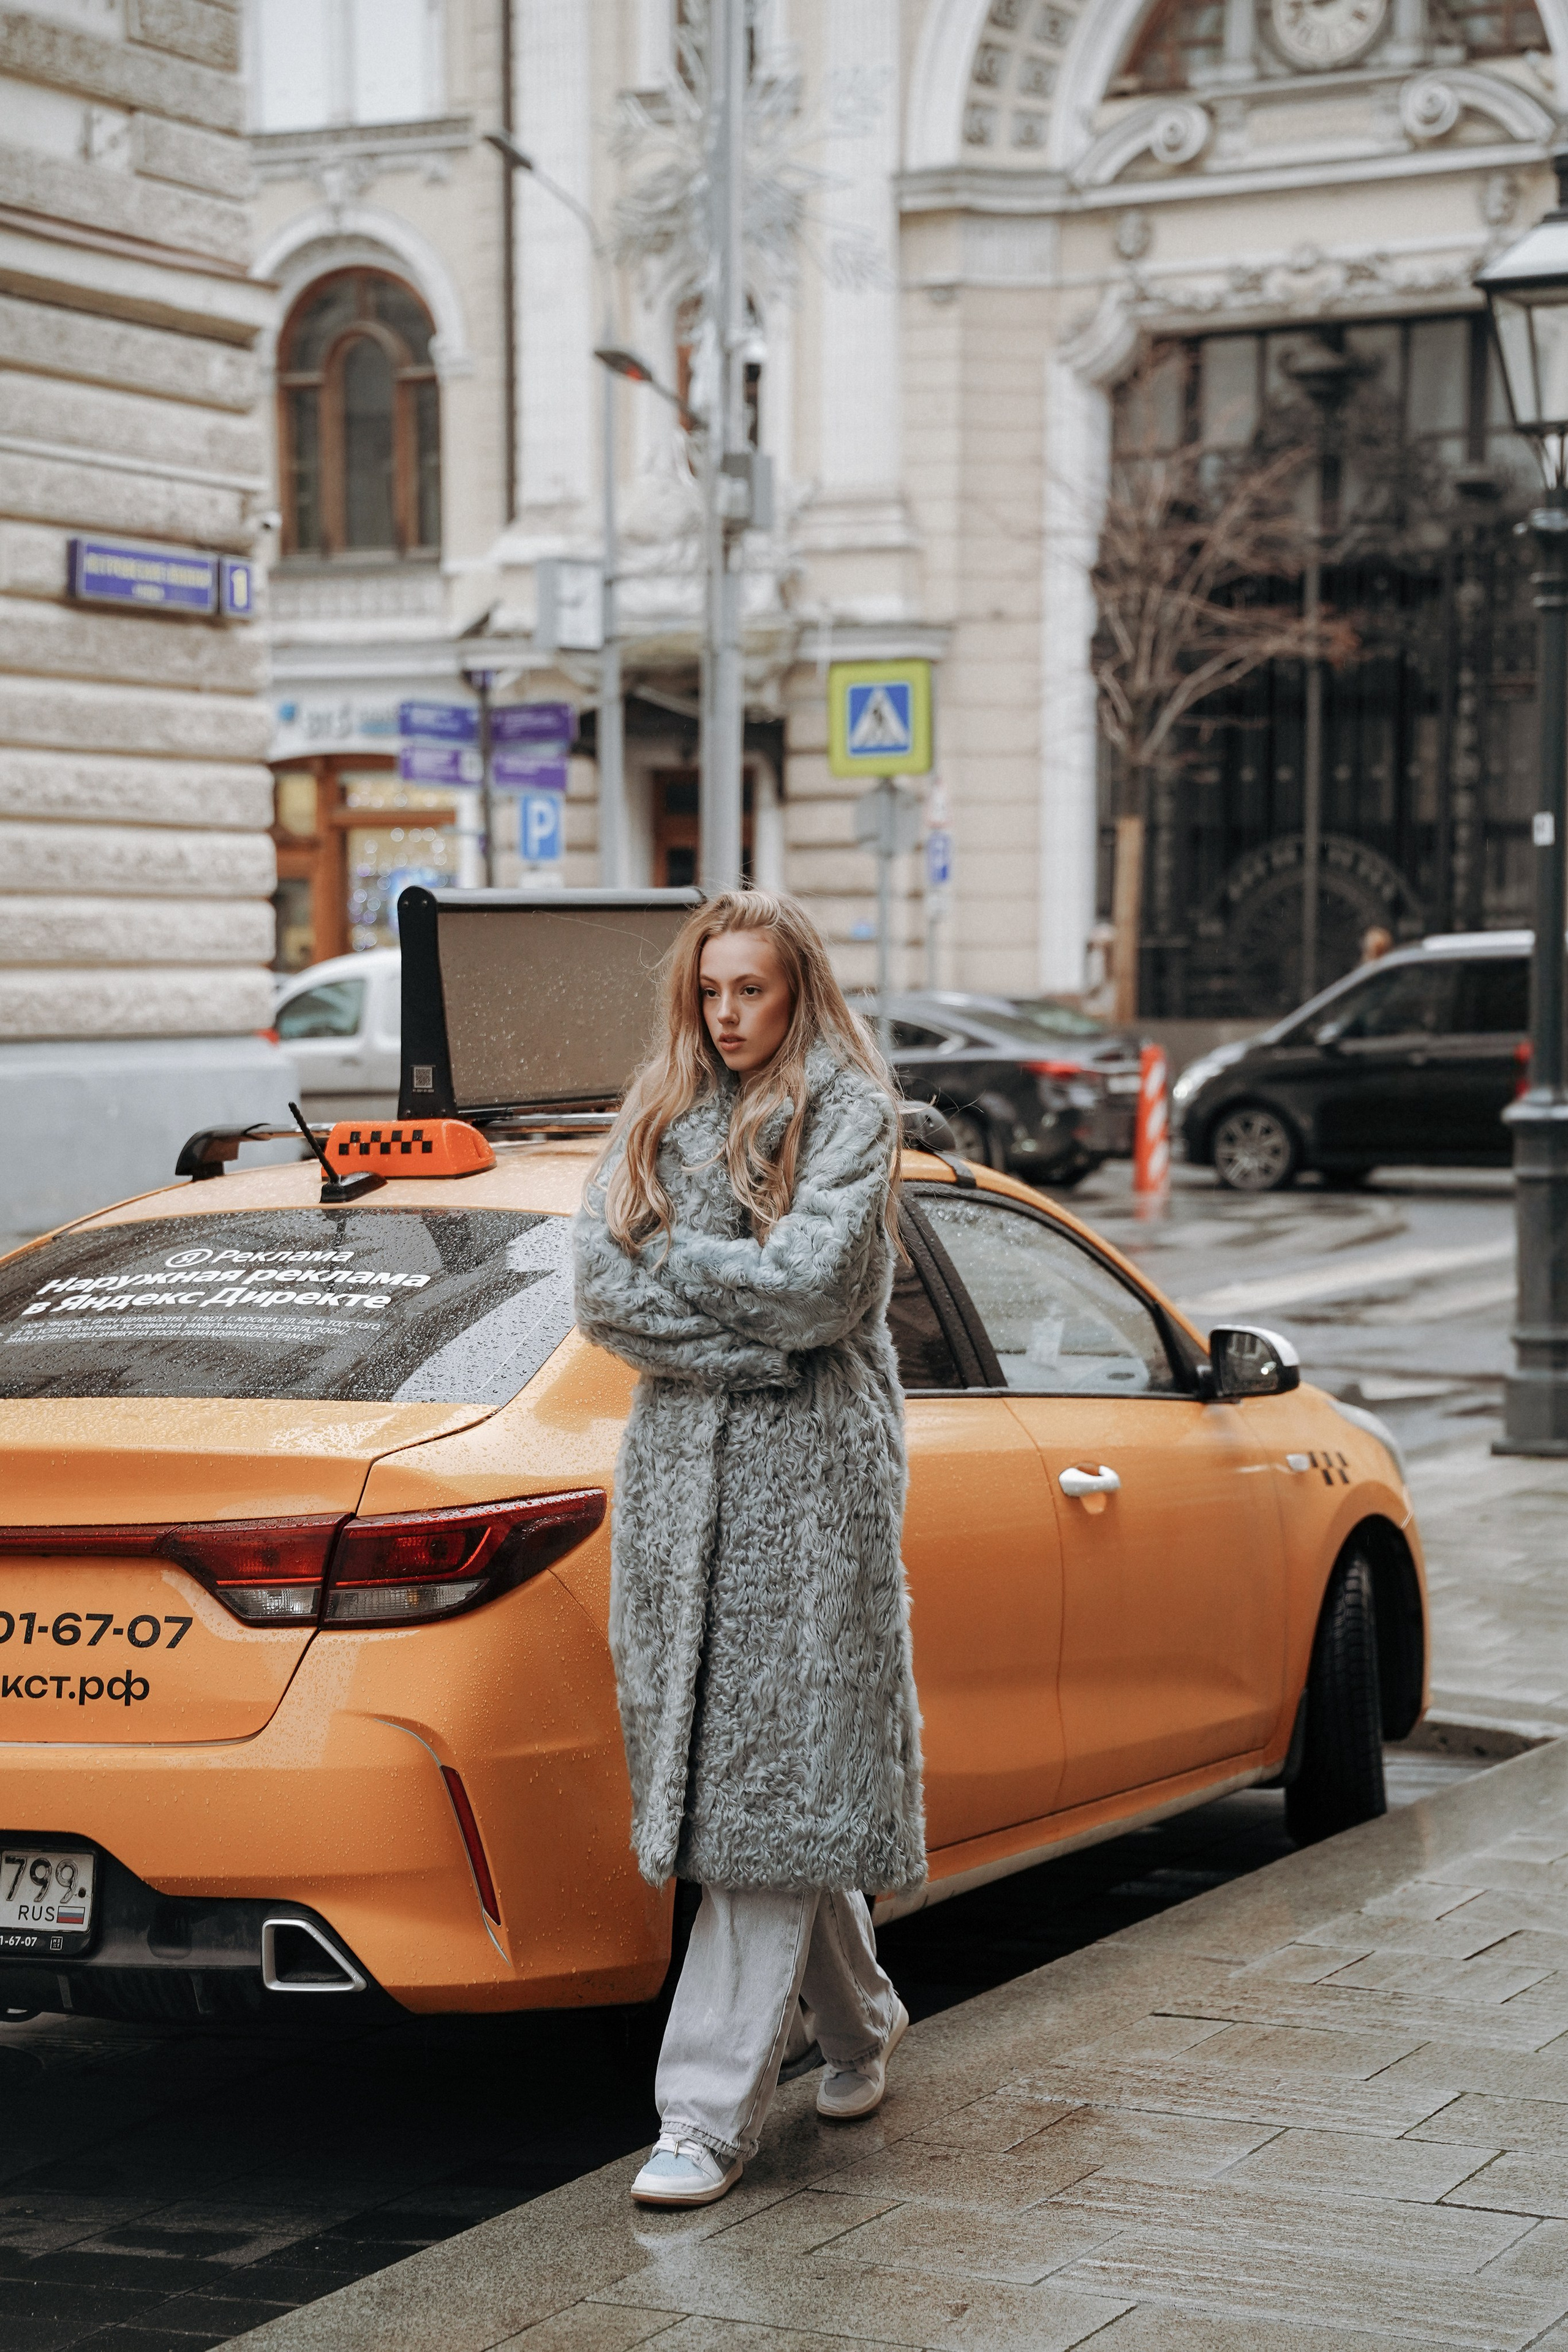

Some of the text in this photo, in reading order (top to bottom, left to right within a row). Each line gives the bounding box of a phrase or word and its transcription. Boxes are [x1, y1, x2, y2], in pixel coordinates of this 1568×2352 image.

[211, 1250, 355, 1263] Реклама
[36, 1269, 431, 1295] Наружная реклама
[21, 1287, 392, 1316] в Яндекс Директе
[327, 1320, 381, 1331] ТОЛСТОГО,
[2, 1670, 149, 1706] кст.рф
[5, 1856, 78, 1904] 799
[18, 1905, 55, 1922] RUS
